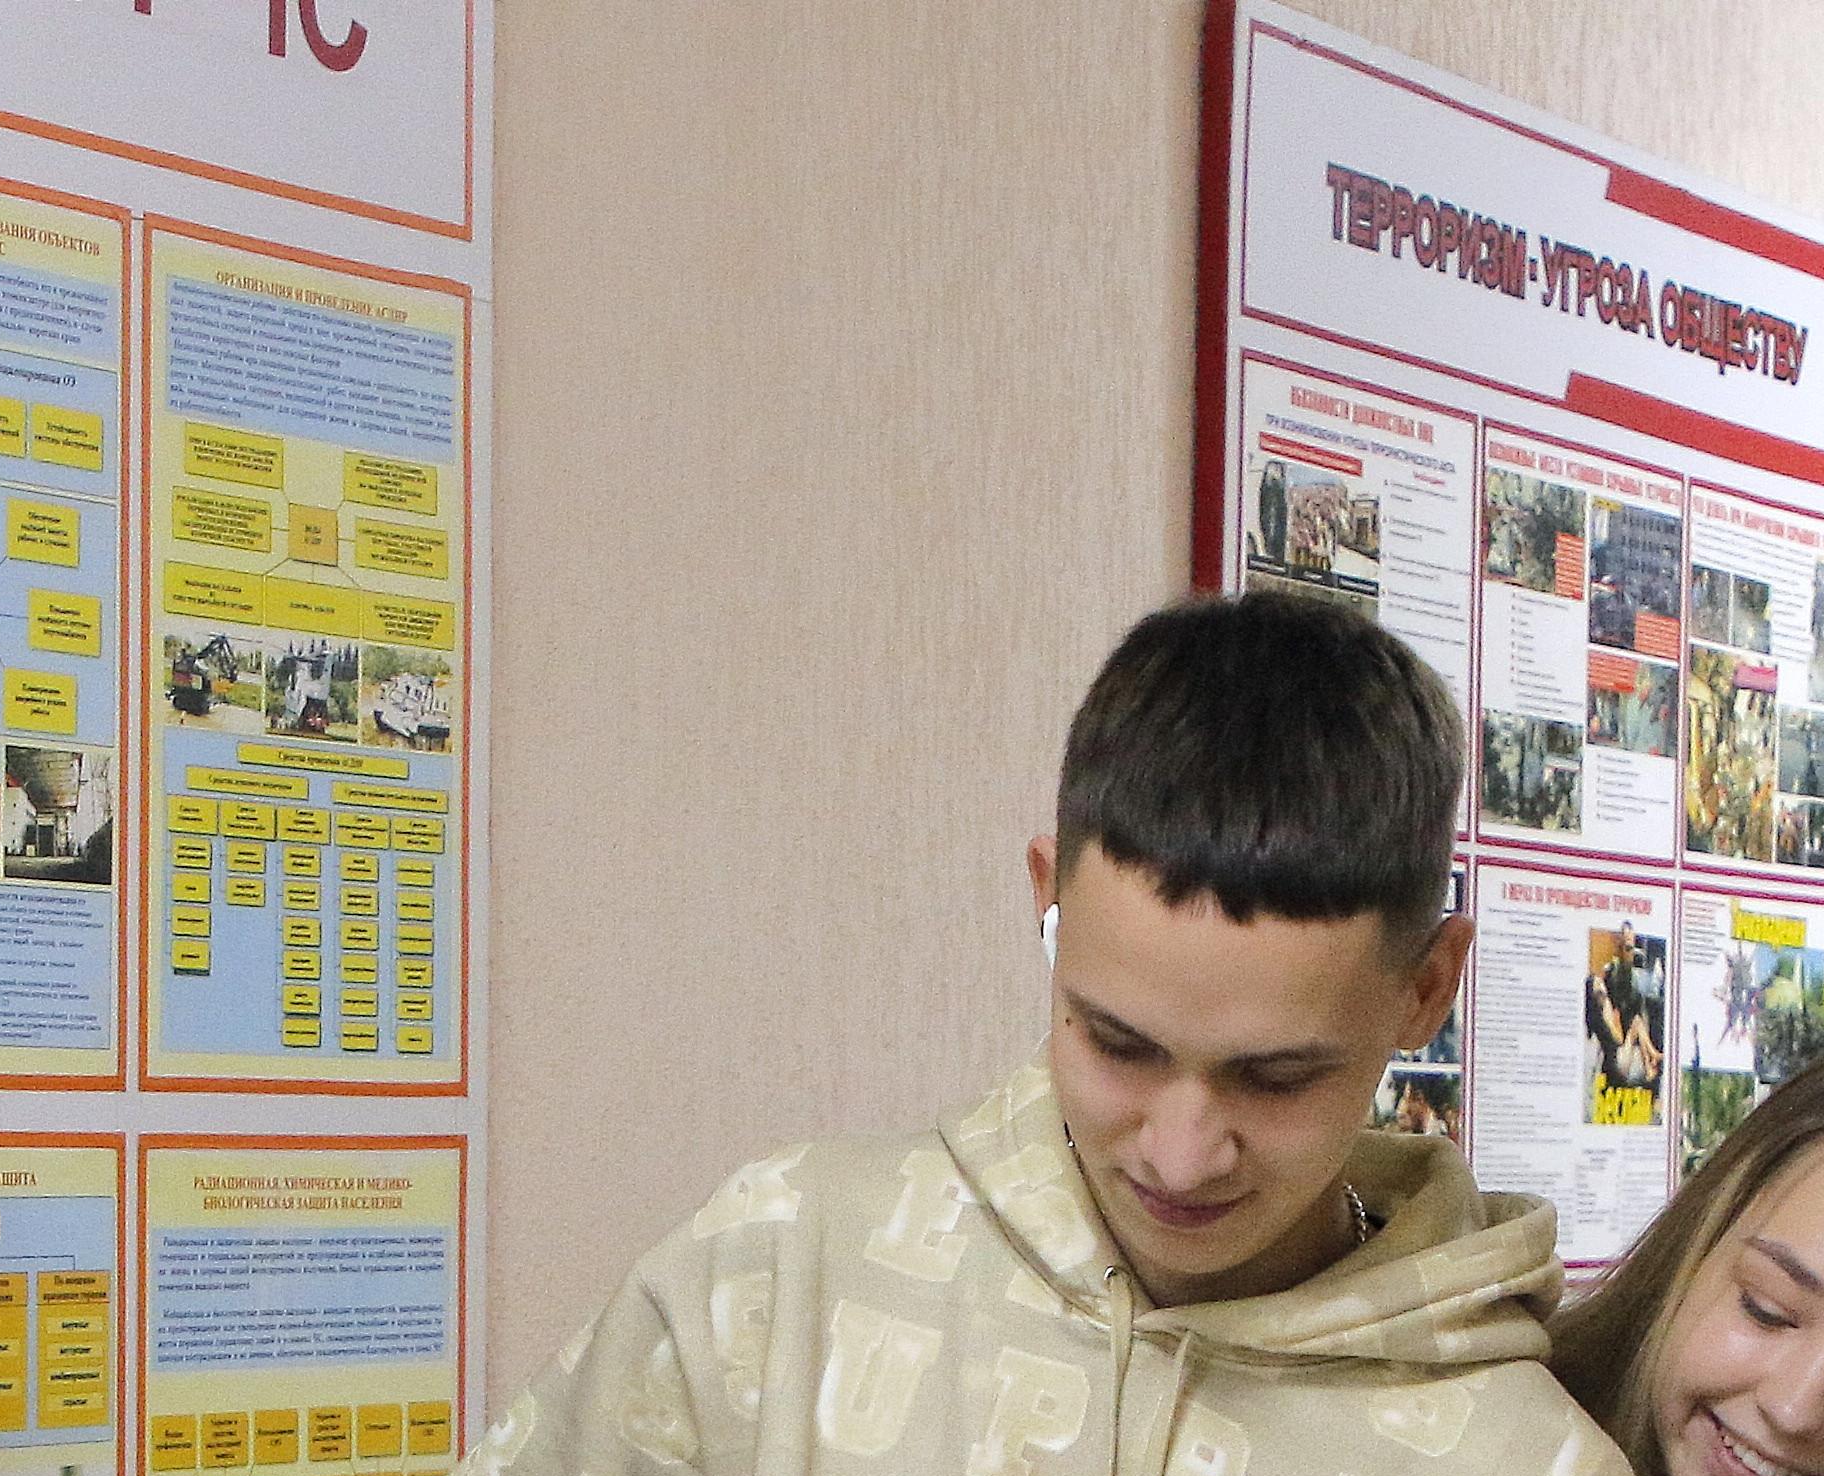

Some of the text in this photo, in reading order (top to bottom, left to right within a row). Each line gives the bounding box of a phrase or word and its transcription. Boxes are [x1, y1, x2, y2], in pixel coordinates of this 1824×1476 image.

[267, 0, 367, 71] С
[1327, 160, 1526, 300] ТЕРРОРИЗМ
[1540, 234, 1655, 339] УГРОЗА
[1660, 279, 1809, 386] ОБЩЕСТВУ
